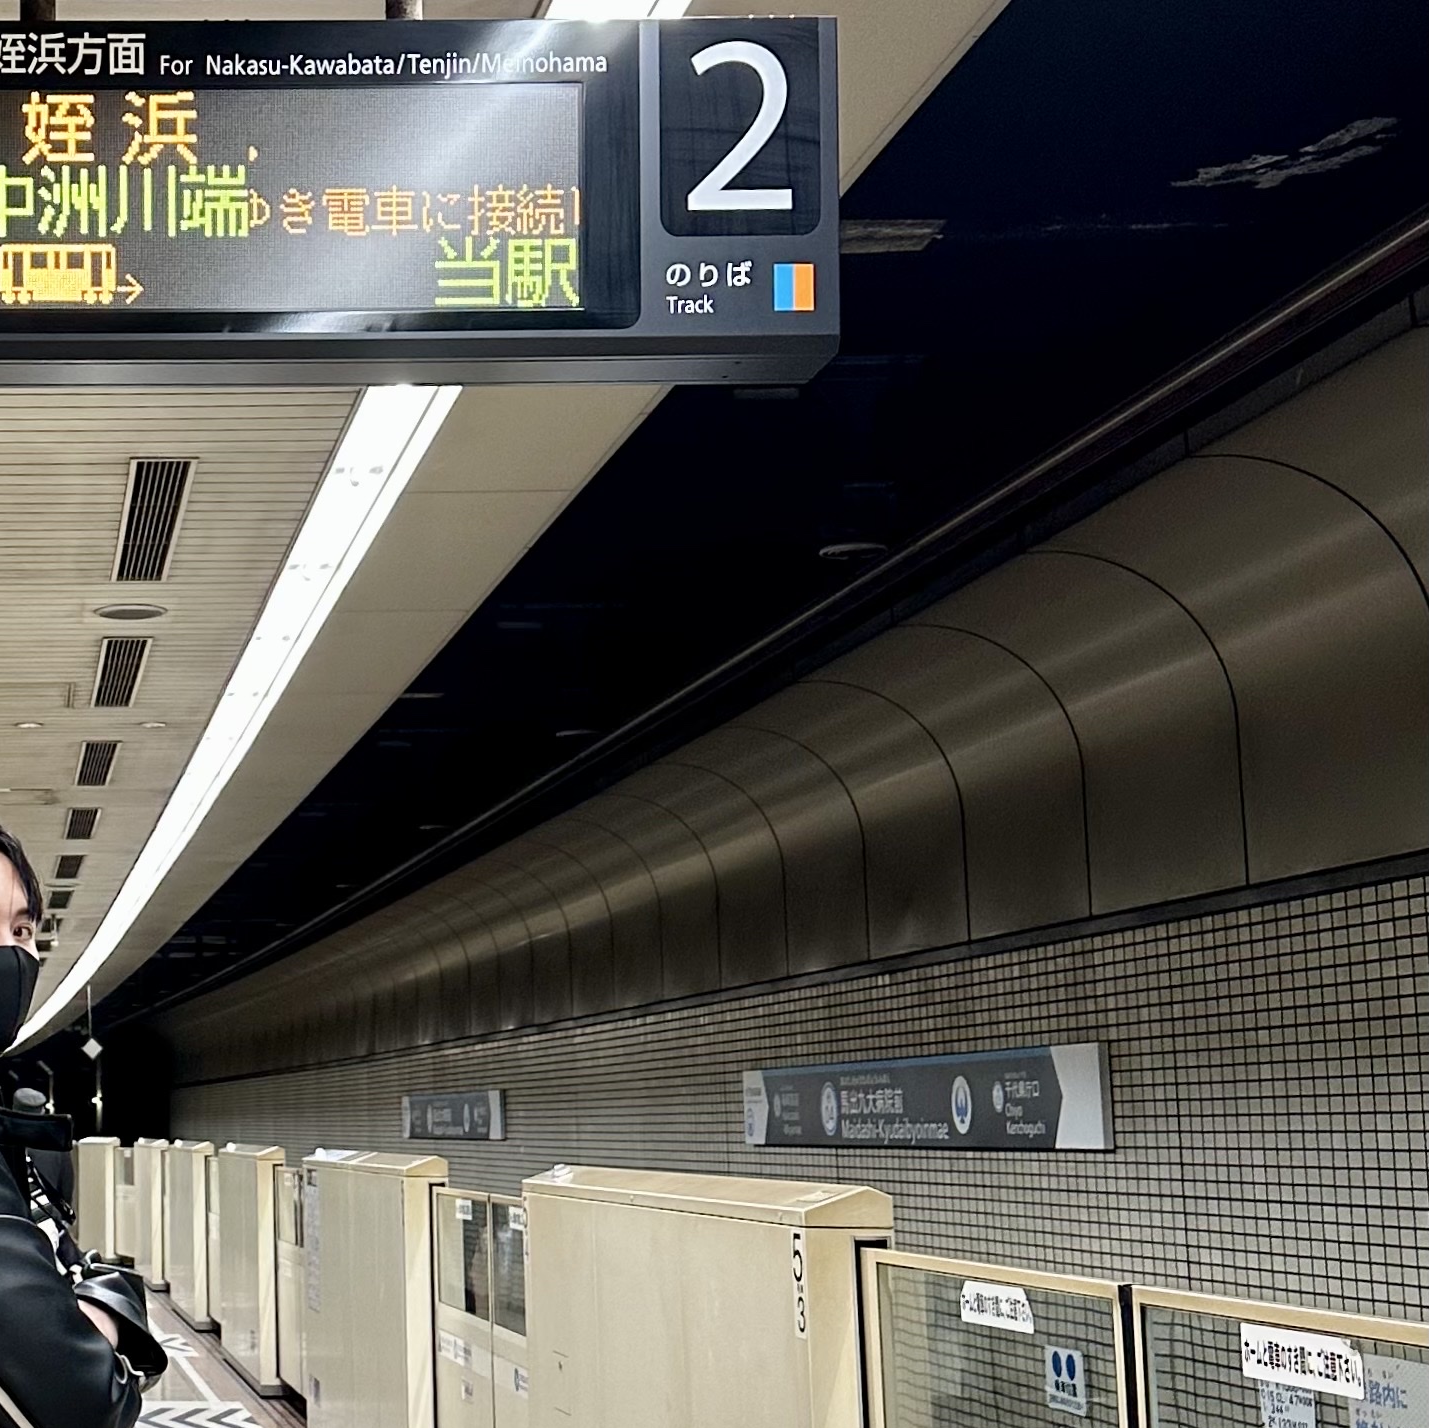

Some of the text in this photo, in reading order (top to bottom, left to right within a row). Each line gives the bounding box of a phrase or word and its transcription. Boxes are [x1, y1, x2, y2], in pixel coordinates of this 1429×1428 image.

[160, 54, 193, 76] For
[687, 40, 792, 212] 2
[434, 236, 580, 308] 当駅
[666, 260, 752, 287] のりば
[666, 295, 714, 314] Track
[793, 1232, 803, 1283] 5
[797, 1296, 807, 1333] 3
[1364, 1380, 1408, 1410] 路内に
